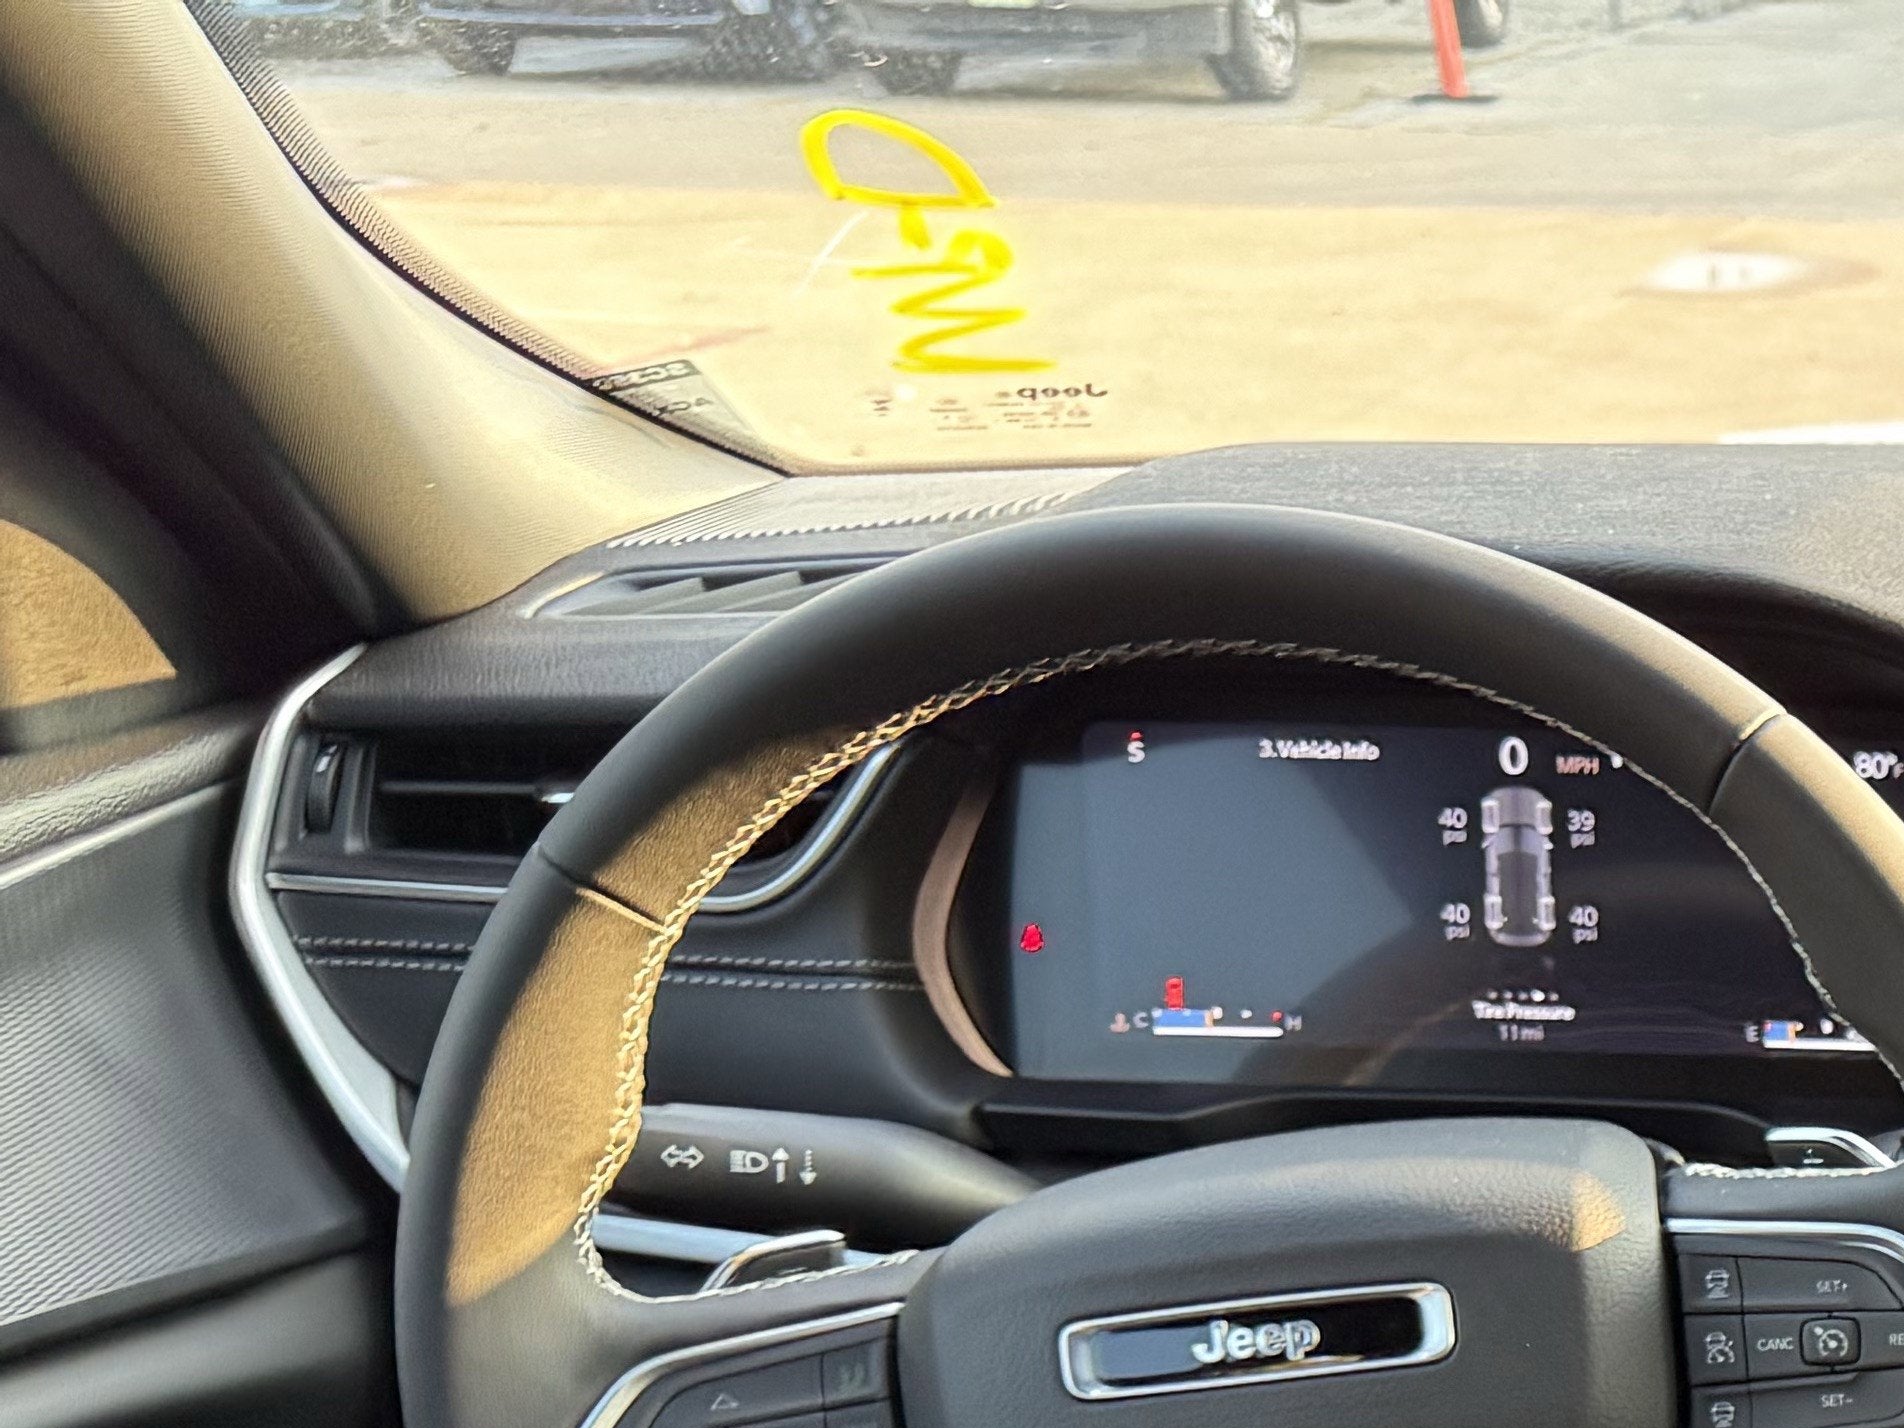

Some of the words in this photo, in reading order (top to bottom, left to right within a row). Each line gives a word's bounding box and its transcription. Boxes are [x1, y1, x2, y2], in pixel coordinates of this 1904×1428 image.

[1498, 736, 1529, 775] 0
[1556, 754, 1600, 775] MPH
[1437, 807, 1468, 829] 40
[1567, 808, 1595, 832] 39
[1440, 903, 1470, 924] 40
[1569, 905, 1599, 927] 40
[1190, 1318, 1322, 1364] Jeep
[1756, 1337, 1795, 1351] CANC
